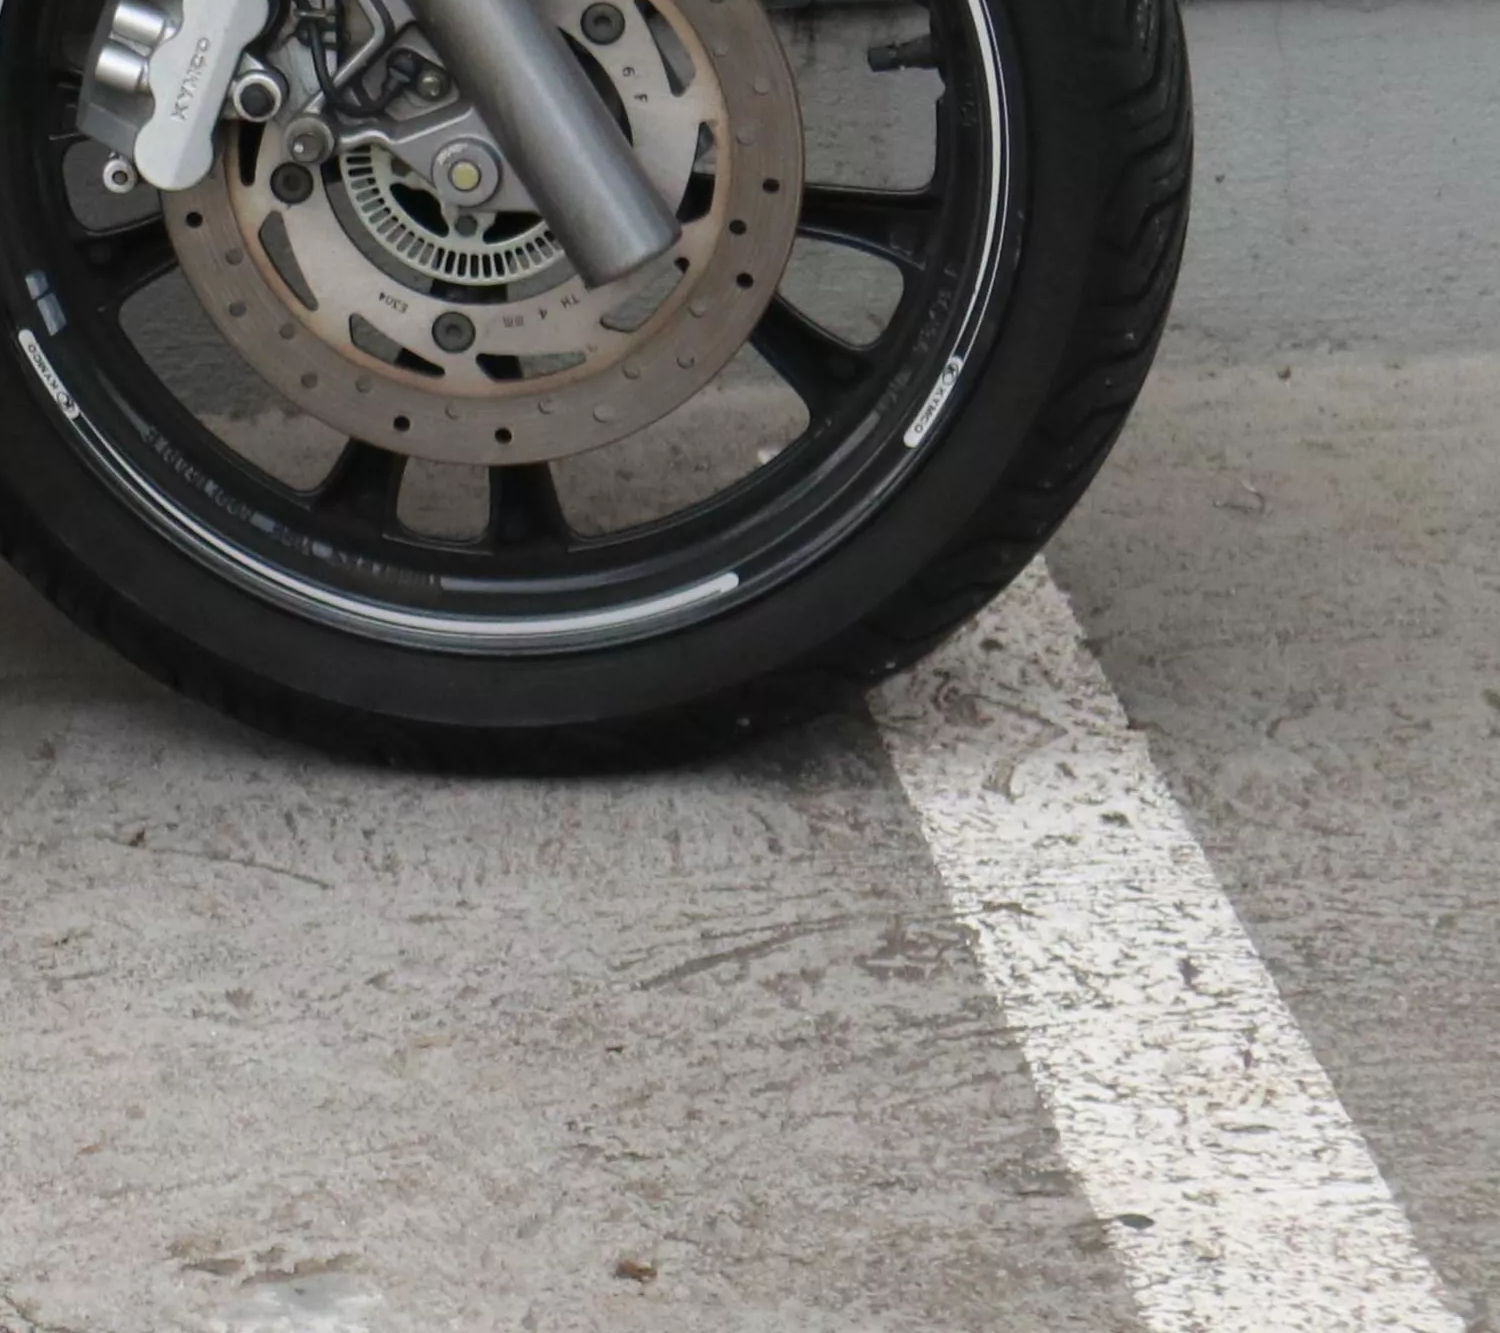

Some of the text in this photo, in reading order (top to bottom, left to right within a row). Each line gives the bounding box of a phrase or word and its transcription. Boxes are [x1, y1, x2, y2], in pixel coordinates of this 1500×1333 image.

[170, 37, 212, 121] KYMCO
[27, 343, 59, 390] KYMCO
[914, 387, 945, 434] KYMCO
